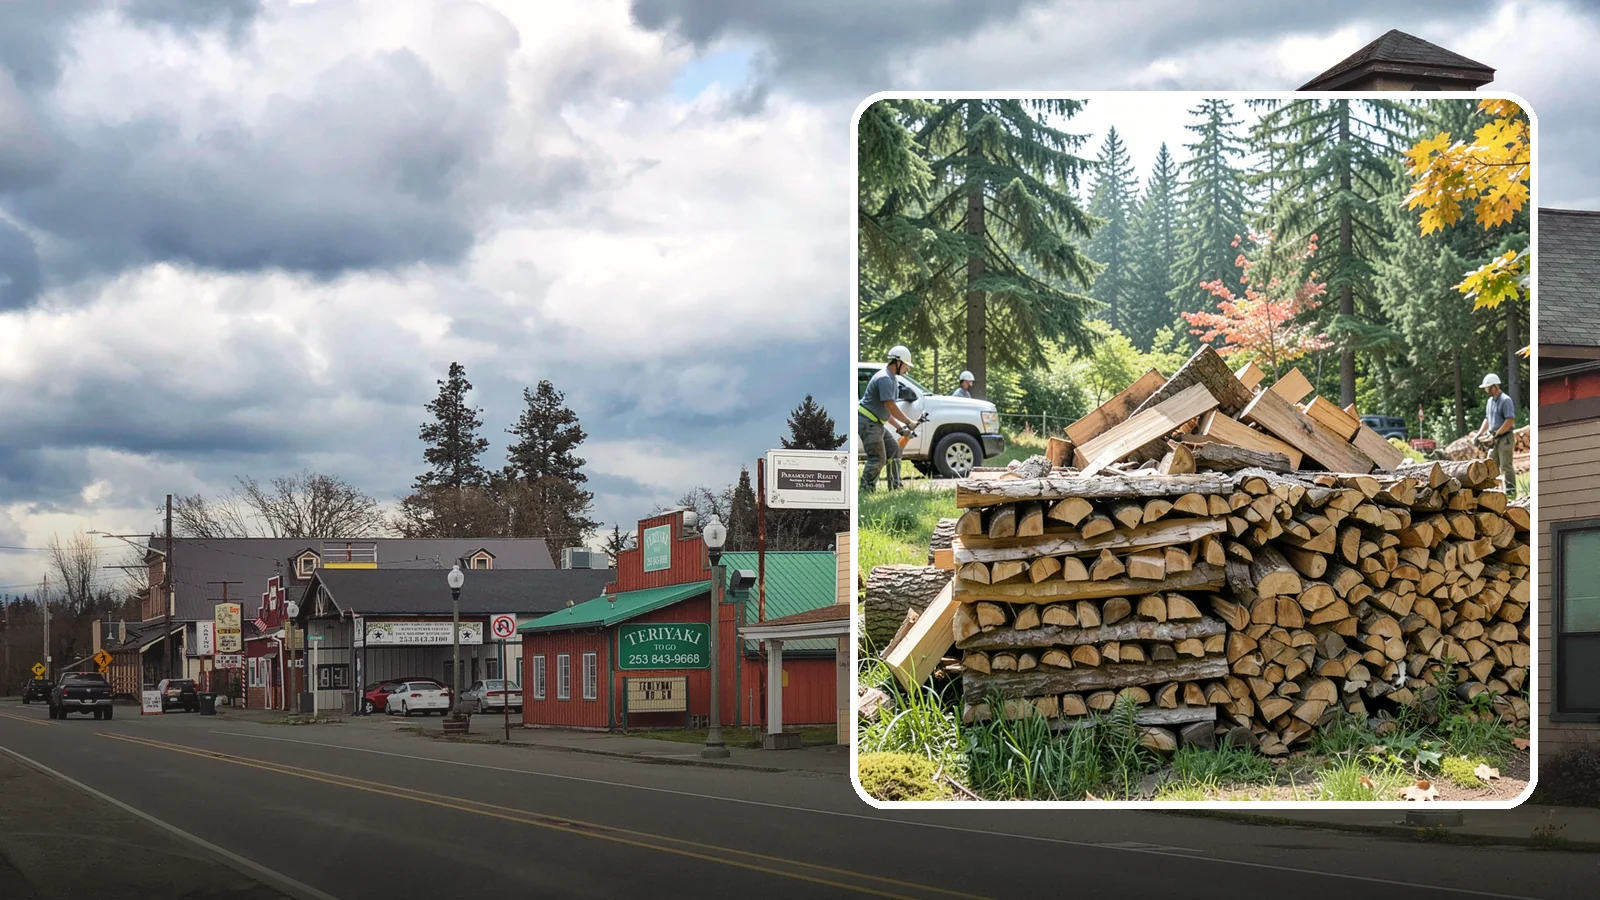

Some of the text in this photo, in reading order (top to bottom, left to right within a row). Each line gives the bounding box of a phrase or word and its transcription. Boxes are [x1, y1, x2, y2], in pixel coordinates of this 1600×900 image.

[781, 471, 814, 479] PARAMOUNT
[625, 627, 702, 645] TERIYAKI
[629, 654, 700, 664] 253 843-9668
[639, 681, 672, 691] TERIYAKI
